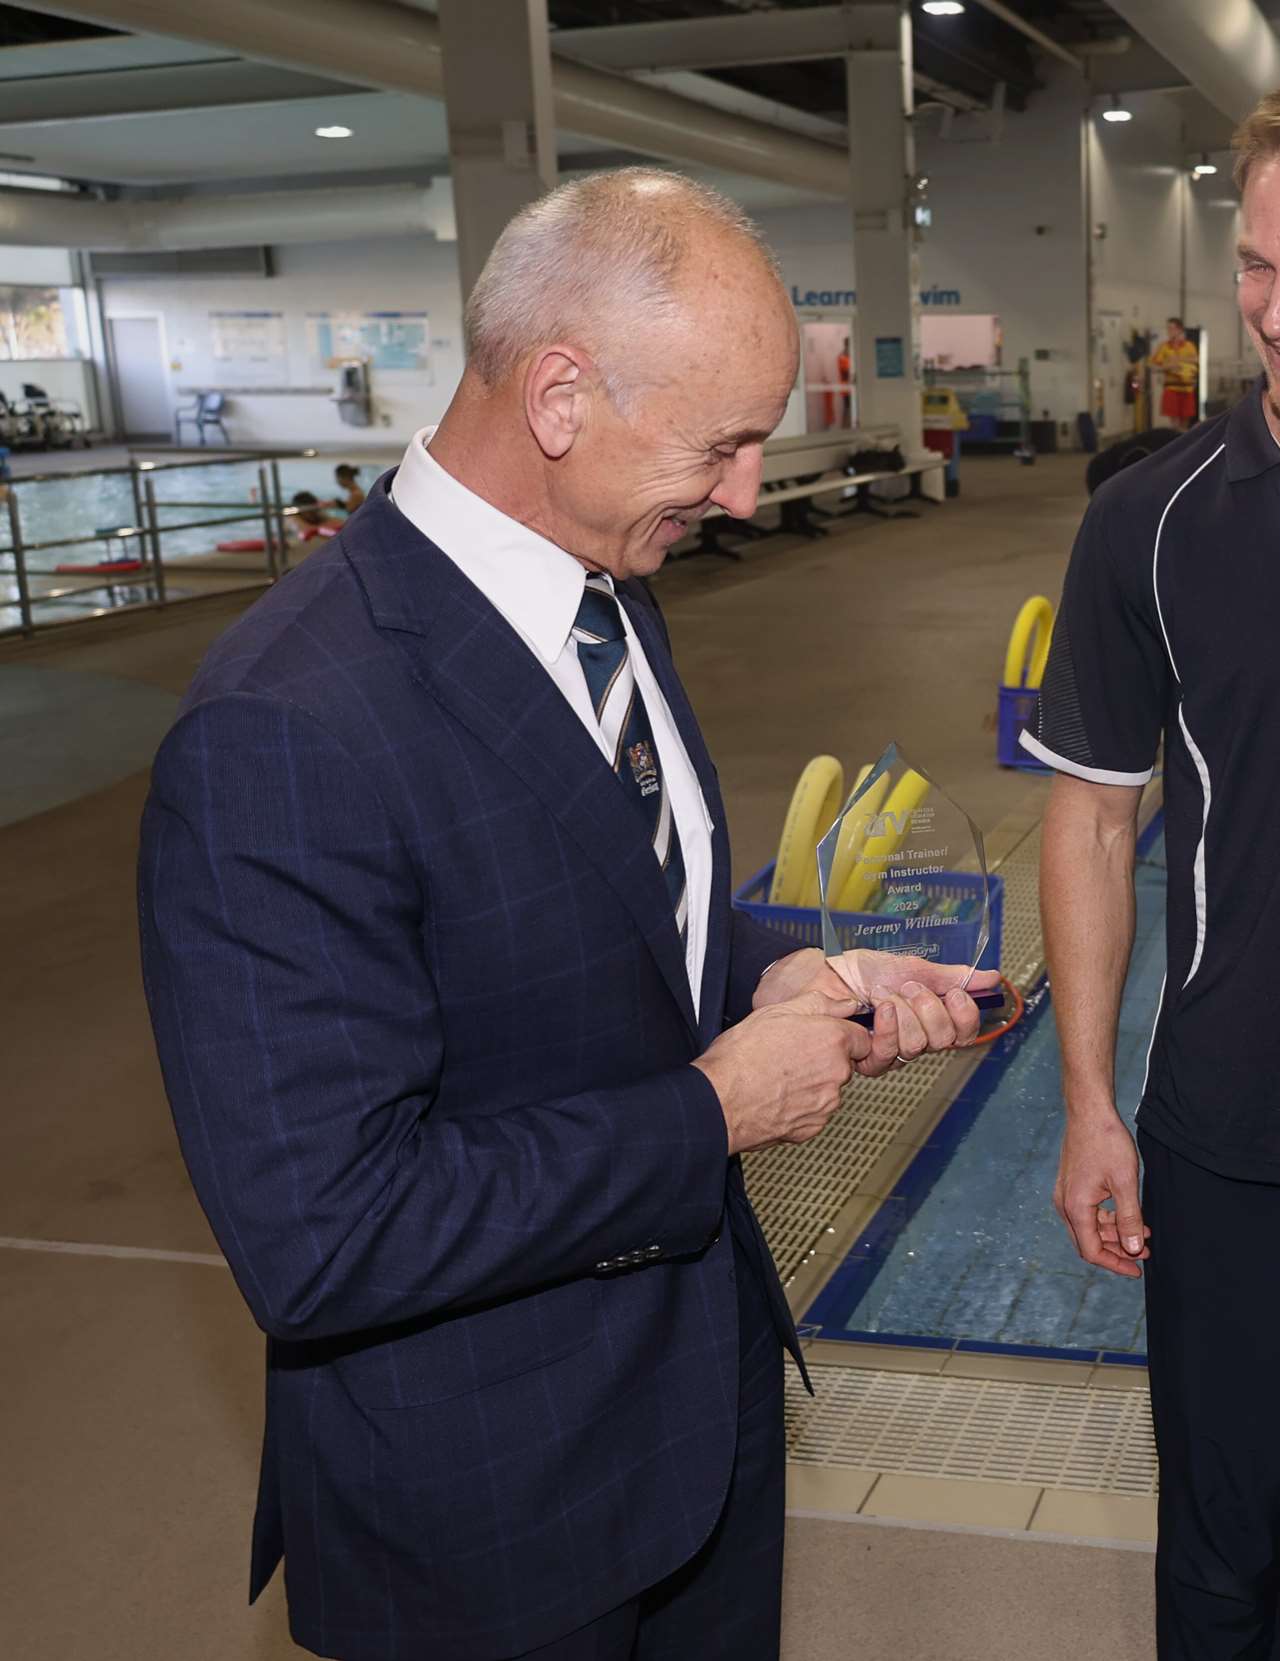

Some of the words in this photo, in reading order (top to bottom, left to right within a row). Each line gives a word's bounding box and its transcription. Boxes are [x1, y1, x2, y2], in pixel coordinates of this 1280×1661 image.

[791, 286, 857, 306] Learn
[890, 865, 945, 878] Instructor
[887, 882, 922, 895] Award
[894, 901, 920, 912] 2025
[854, 923, 901, 936] Jeremy
[905, 914, 959, 930] Williams
